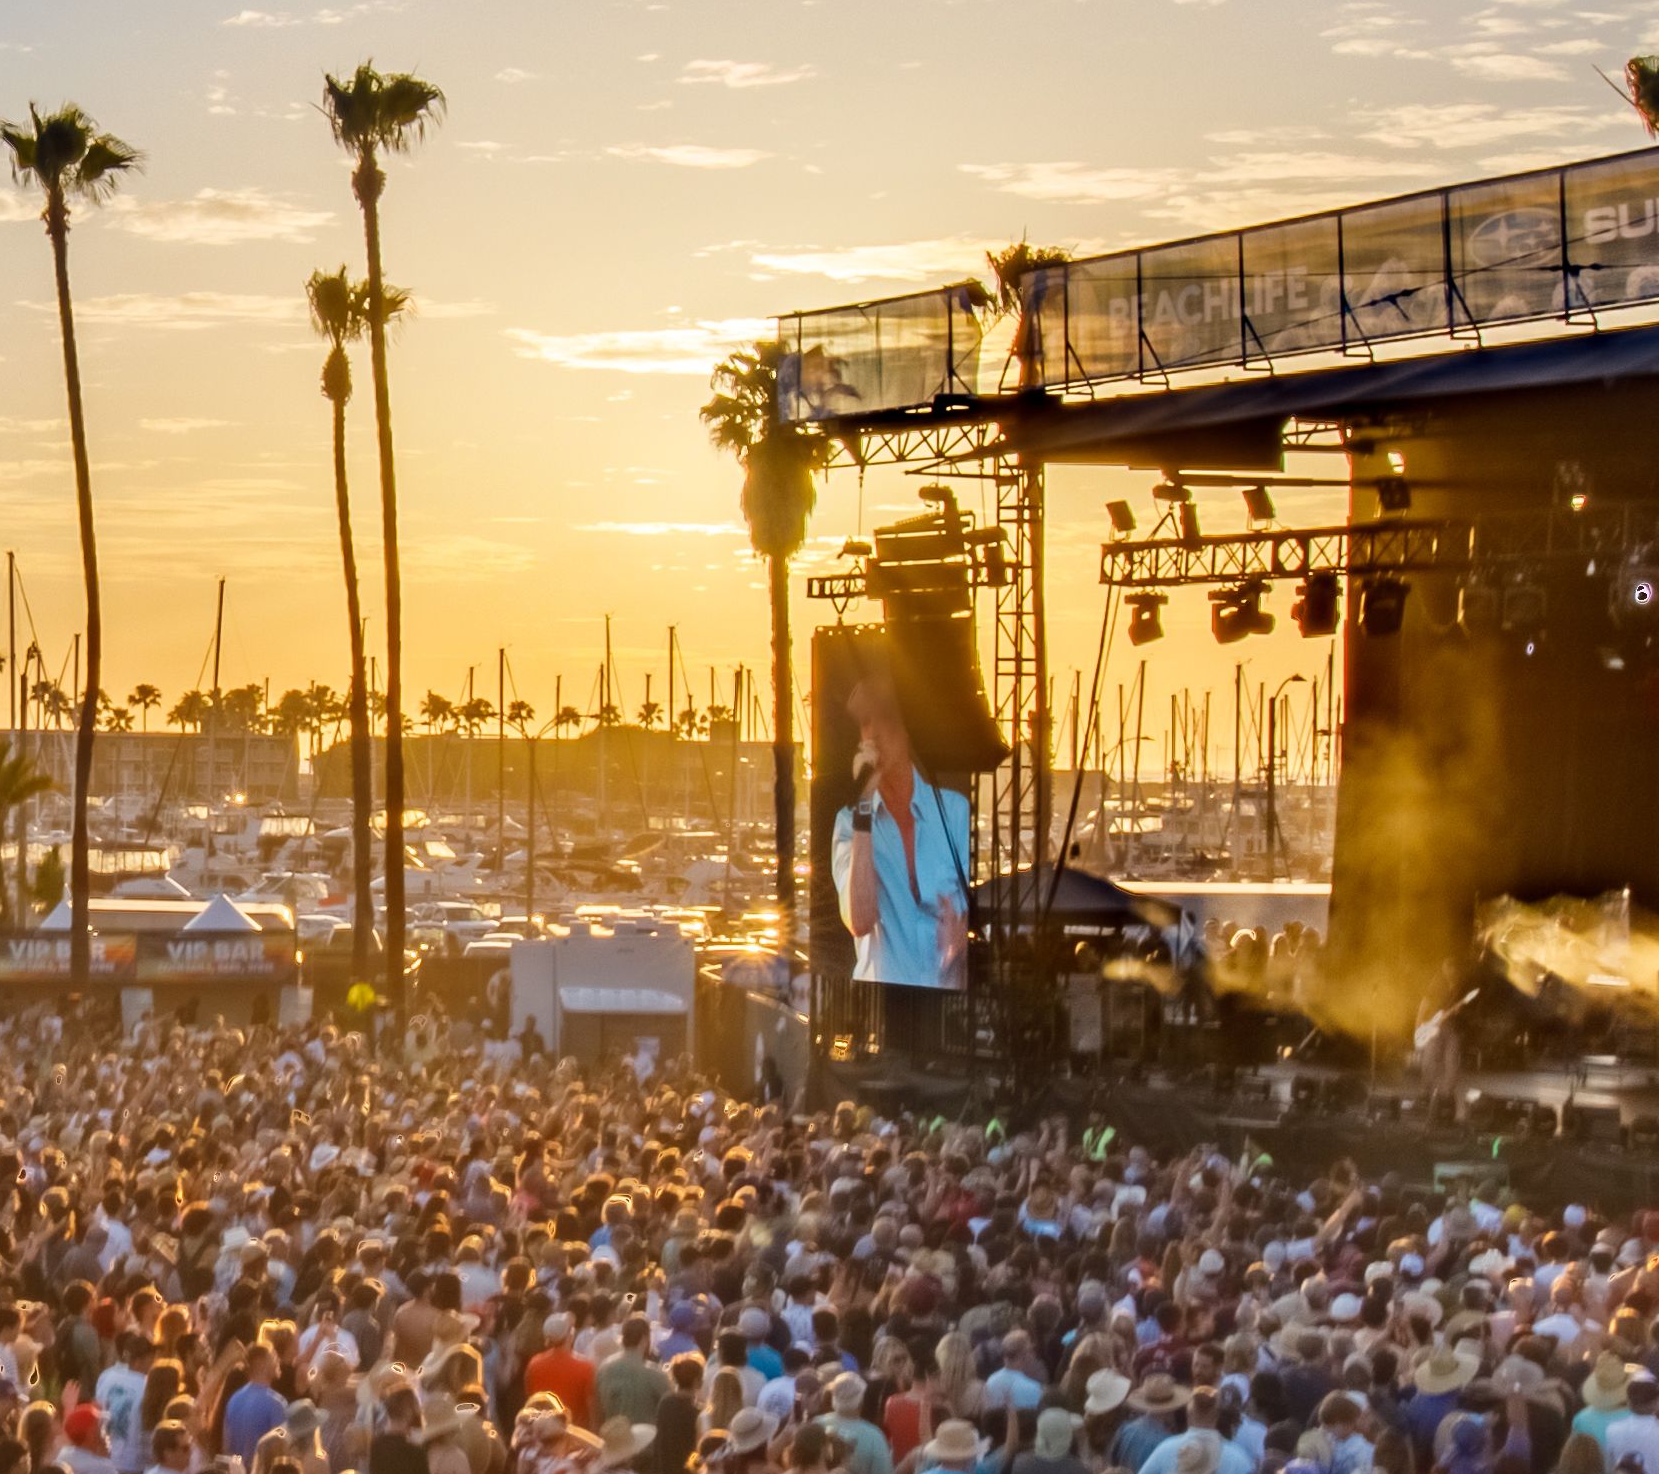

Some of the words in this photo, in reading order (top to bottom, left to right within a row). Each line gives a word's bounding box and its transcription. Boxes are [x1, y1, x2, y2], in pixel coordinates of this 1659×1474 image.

[1108, 266, 1309, 336] BEACHLIFE
[8, 939, 51, 960] VIP
[55, 940, 107, 961] BR
[167, 940, 208, 961] VIP
[214, 940, 265, 962] BAR
